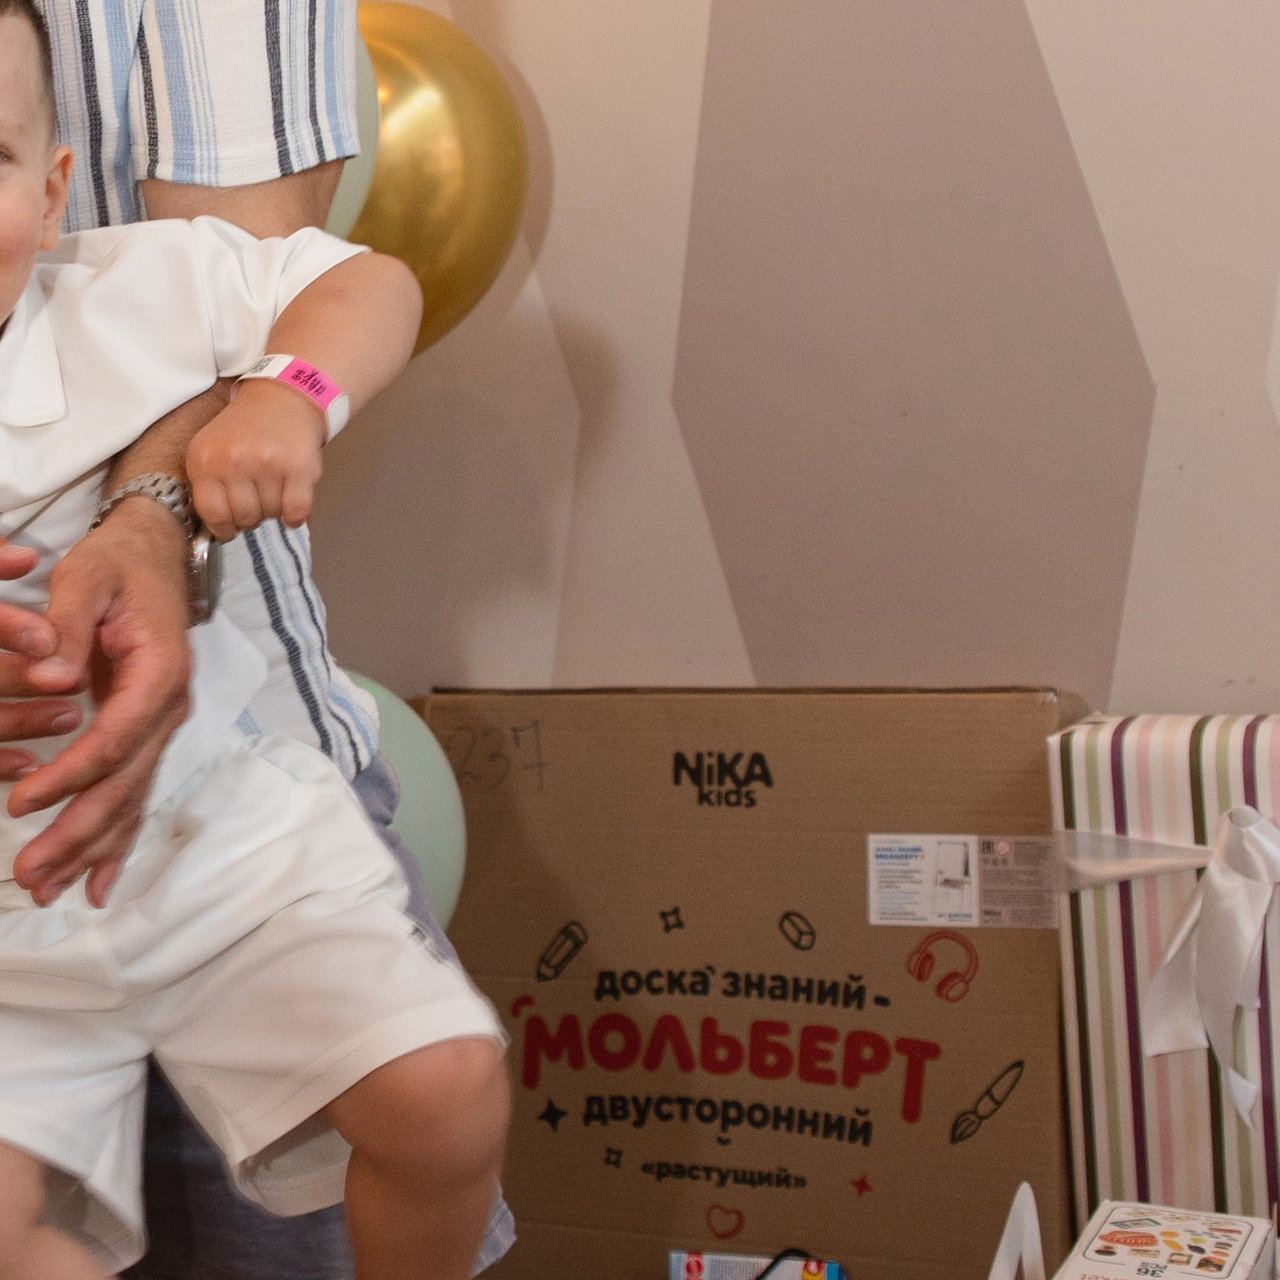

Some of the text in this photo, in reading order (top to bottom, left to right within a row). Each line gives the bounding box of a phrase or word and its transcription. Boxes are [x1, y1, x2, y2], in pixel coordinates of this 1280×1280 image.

[595, 969, 711, 1001] доска
[722, 971, 867, 1010] знаний
[521, 1013, 943, 1124] МОЛЬБЕРТ
[583, 1094, 873, 1147] двусторонний
[1136, 1267, 1165, 1277] 36
